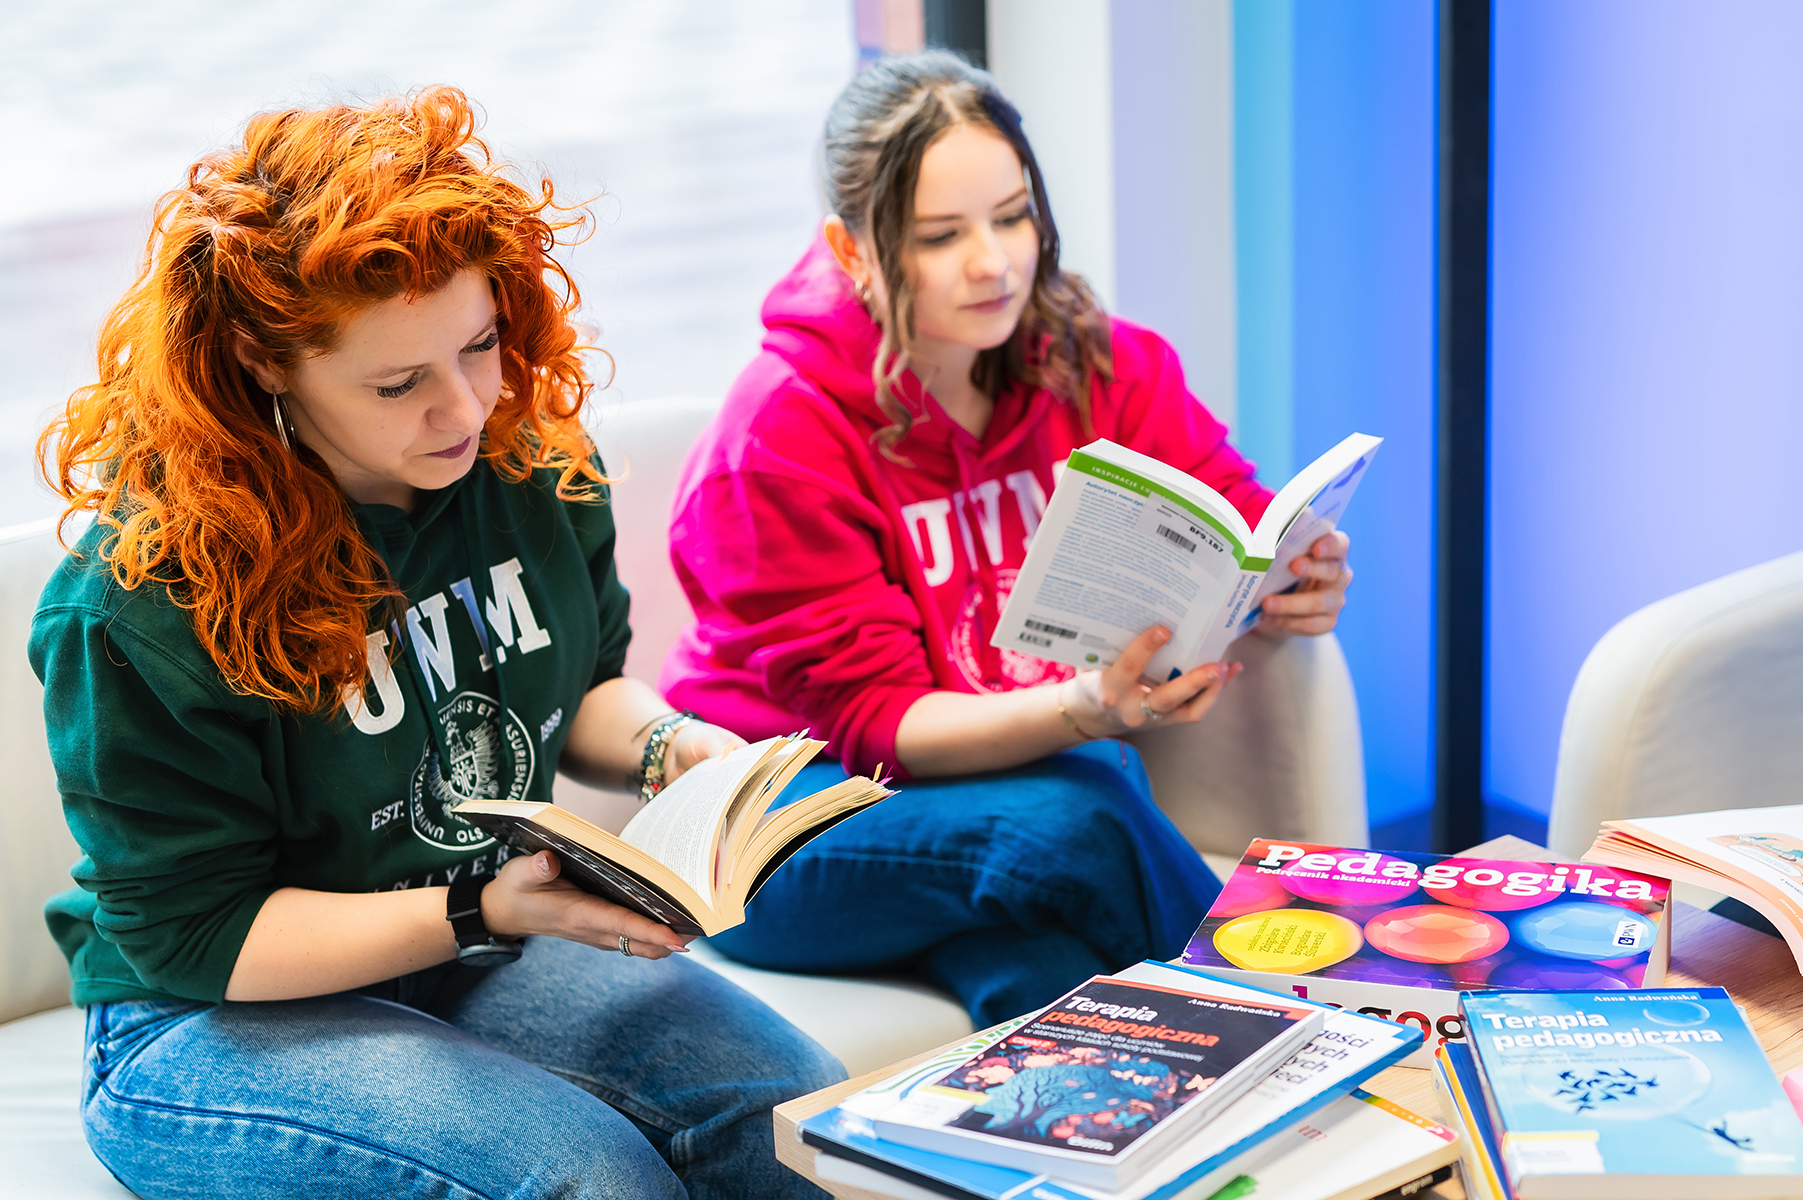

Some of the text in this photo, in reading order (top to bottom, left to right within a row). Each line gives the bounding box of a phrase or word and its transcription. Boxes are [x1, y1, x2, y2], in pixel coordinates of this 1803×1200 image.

[1091, 466, 1138, 488] INSPIRACJE
[1086, 481, 1118, 496] Autorytet
[1118, 493, 1145, 508] nauczyc
[341, 557, 551, 735] UWM
[477, 702, 496, 719] ET
[504, 722, 528, 801] ASURIENSIS
[371, 800, 404, 831] EST.
[456, 827, 484, 844] OLS
[1256, 866, 1411, 887] Podręcznik akademicki
[1258, 844, 1654, 901] Pedagogika
[1064, 996, 1158, 1022] Terapia
[1188, 998, 1281, 1018] Anna Radwańska
[1629, 994, 1698, 1003] Radwańska
[1039, 1011, 1220, 1048] pedagogiczna
[1482, 1011, 1610, 1031] Terapia
[1492, 1027, 1724, 1052] pedagogiczna
